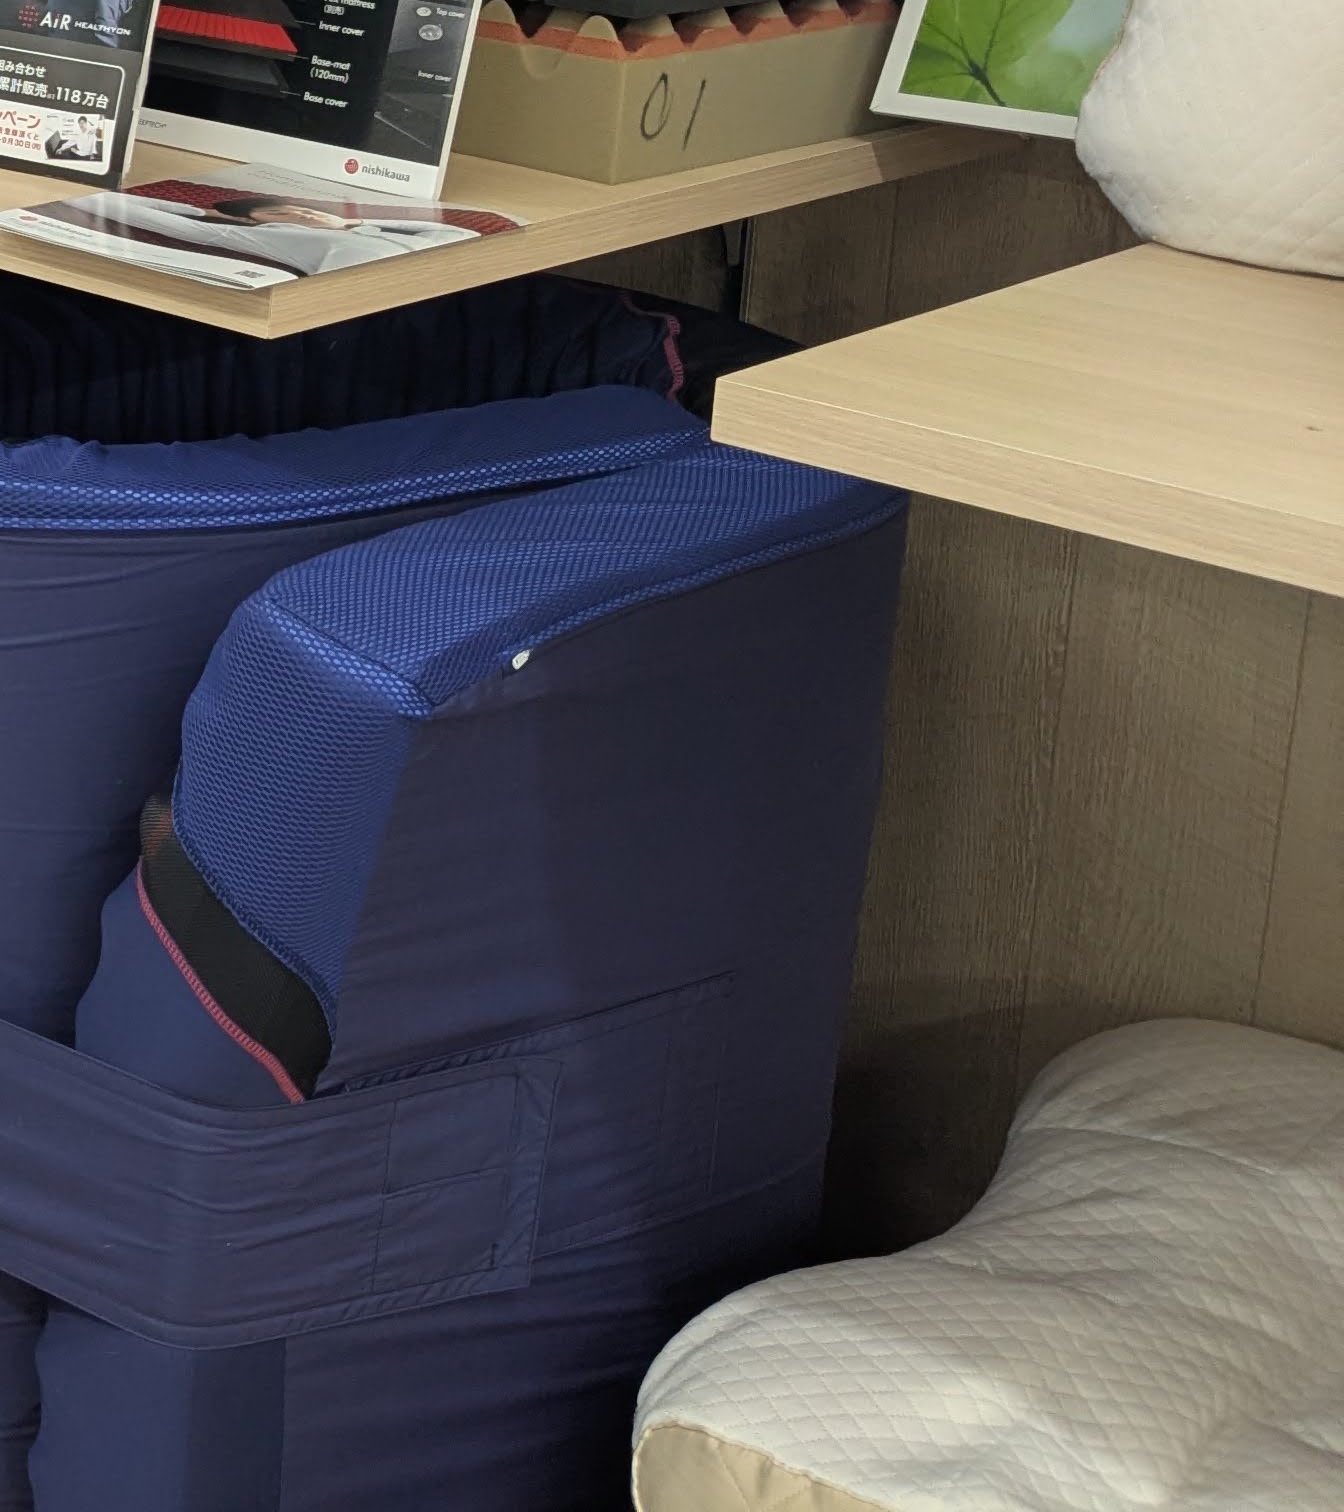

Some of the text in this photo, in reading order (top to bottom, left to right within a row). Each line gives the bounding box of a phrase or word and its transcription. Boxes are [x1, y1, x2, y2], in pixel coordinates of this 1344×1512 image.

[436, 7, 465, 19] Top cover
[74, 20, 131, 36] HEALTHYON
[318, 20, 366, 37] Inner cover
[303, 91, 348, 108] Base cover
[361, 163, 410, 183] nishikawa
